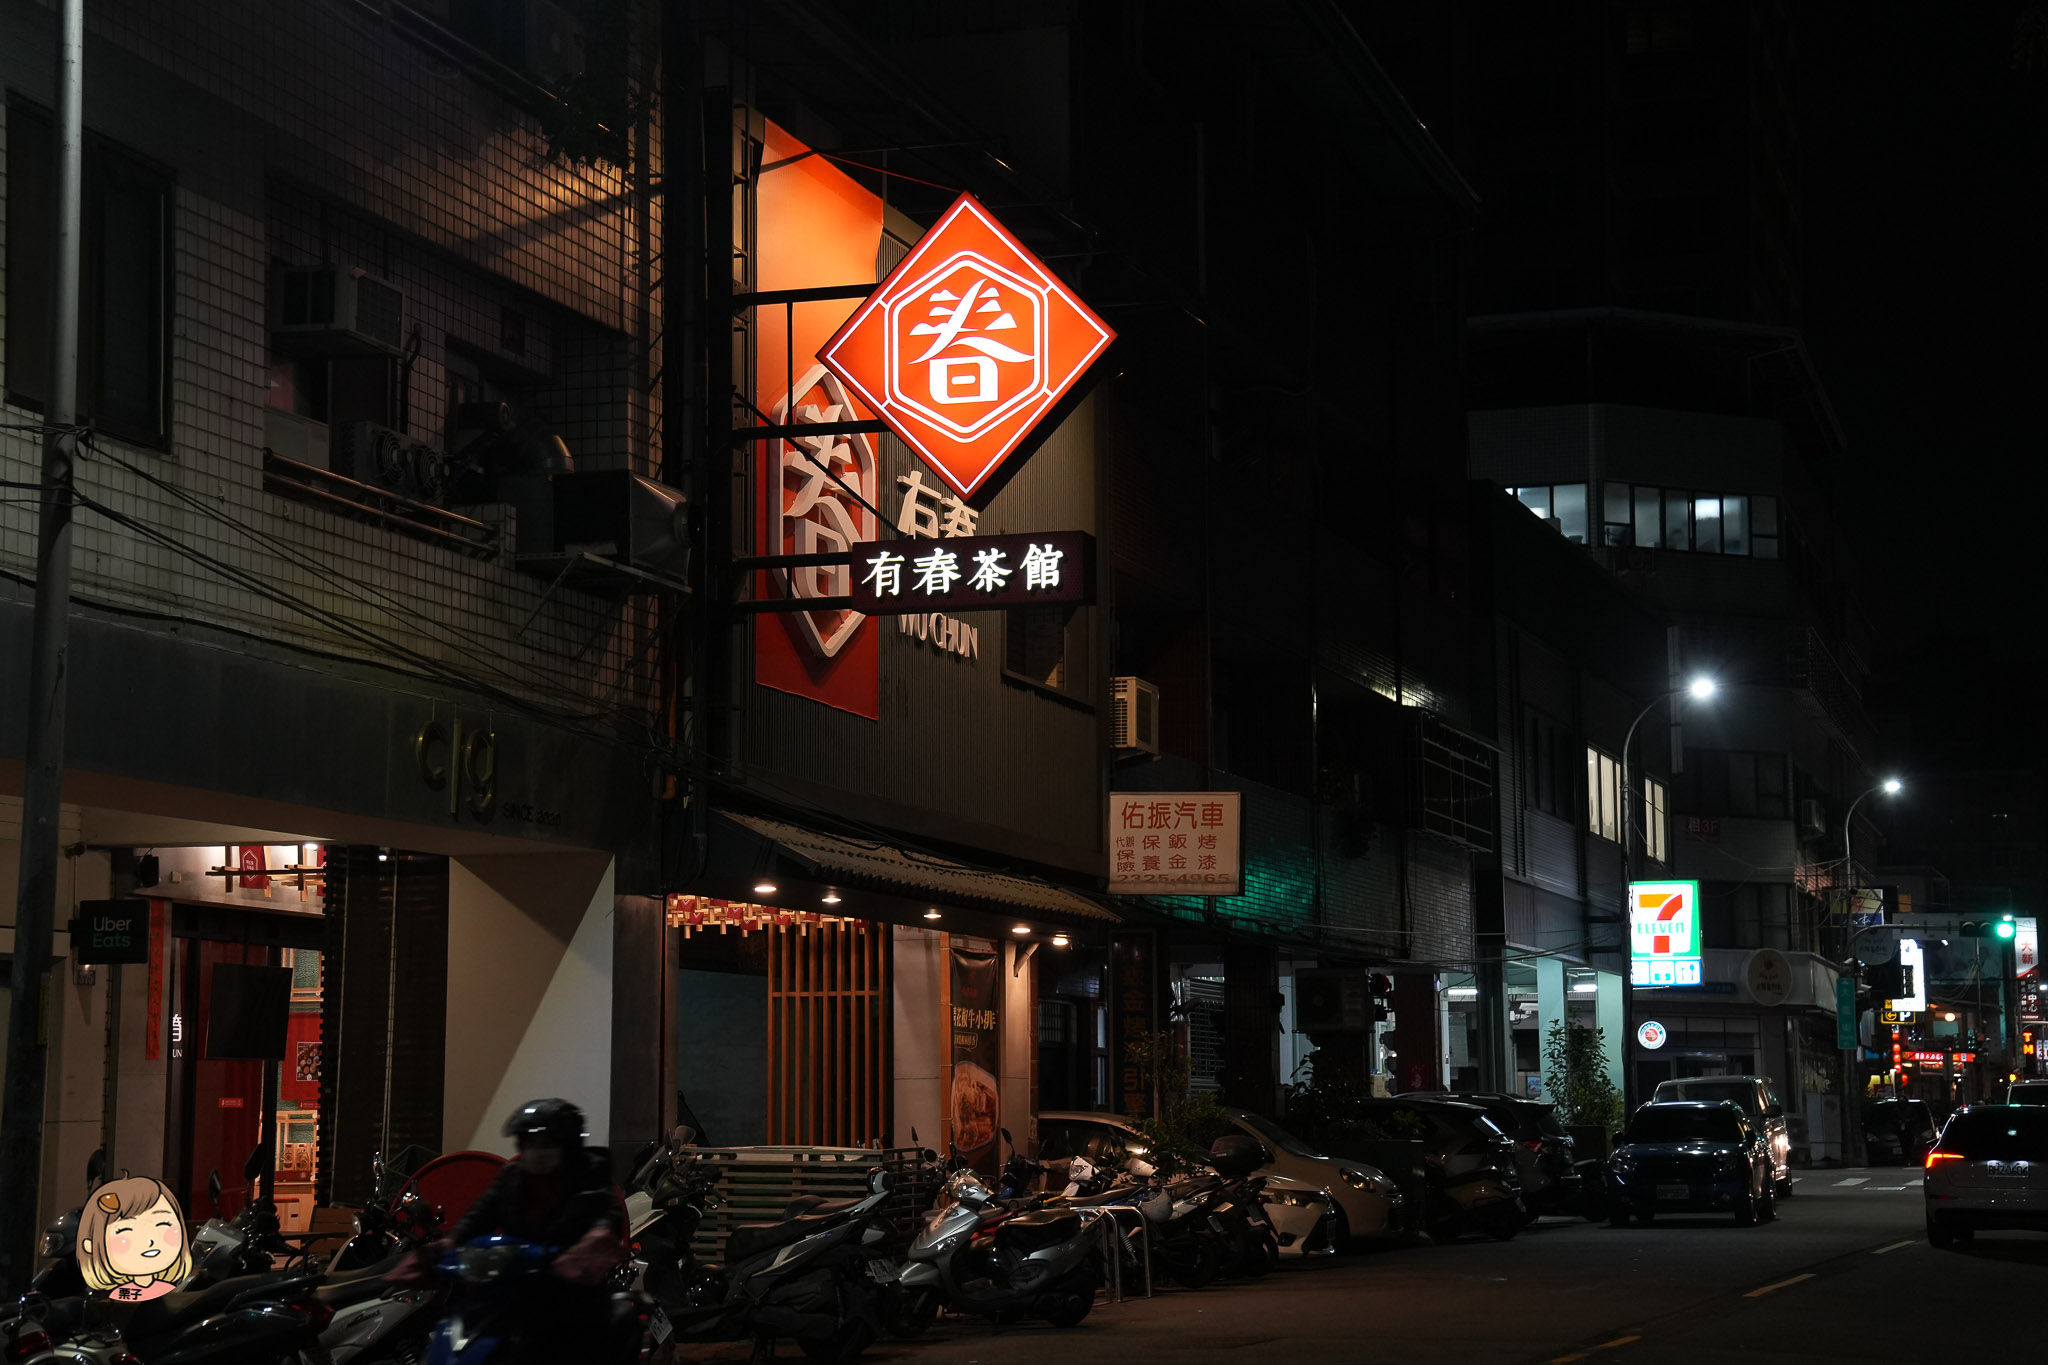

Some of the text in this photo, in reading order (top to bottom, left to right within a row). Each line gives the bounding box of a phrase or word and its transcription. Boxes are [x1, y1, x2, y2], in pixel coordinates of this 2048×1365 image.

[908, 278, 1035, 404] 春
[861, 543, 1064, 598] 有春茶館
[1121, 801, 1224, 830] 佑振汽車
[1142, 834, 1161, 871] 保養
[1168, 833, 1188, 870] 鈑金
[1198, 834, 1218, 870] 烤漆
[92, 932, 132, 949] Eats
[93, 916, 133, 933] Uber
